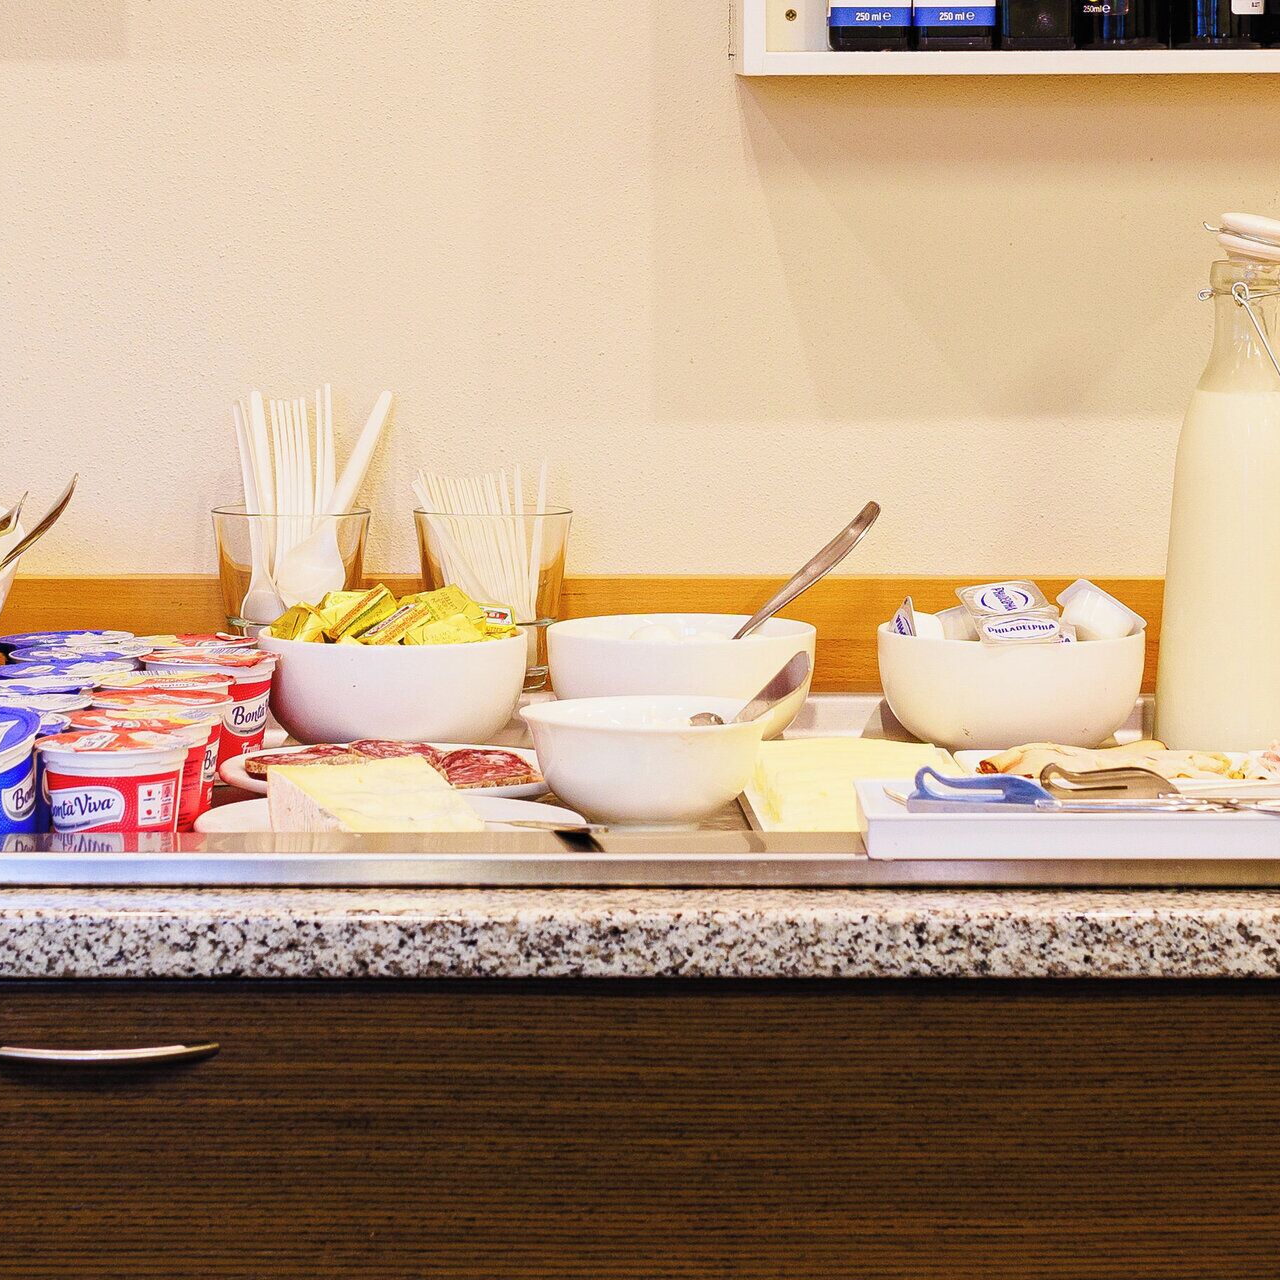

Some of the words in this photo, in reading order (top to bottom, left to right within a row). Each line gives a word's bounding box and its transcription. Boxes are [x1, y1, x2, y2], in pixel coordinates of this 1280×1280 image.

[855, 12, 870, 21] 250
[871, 12, 881, 21] ml
[939, 12, 954, 21] 250
[955, 12, 965, 21] ml
[987, 623, 1055, 634] PHILADELPHIA
[75, 793, 114, 816] Viva
